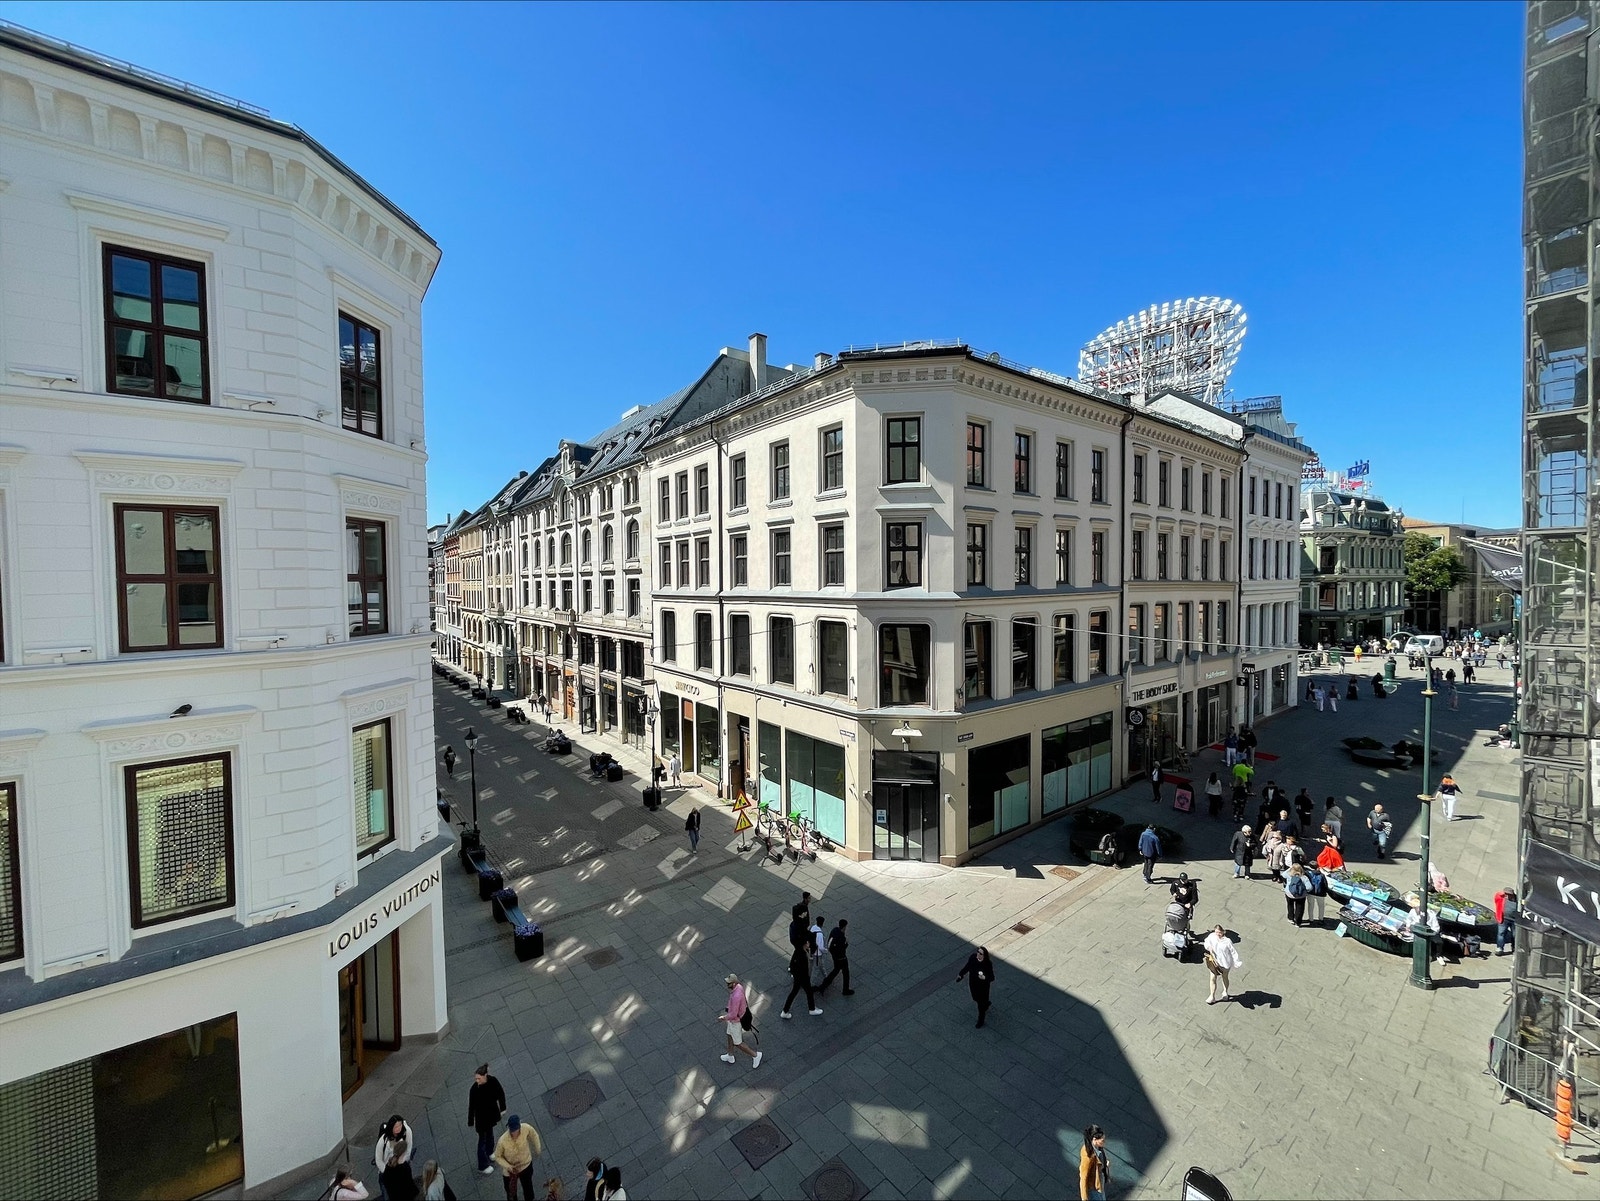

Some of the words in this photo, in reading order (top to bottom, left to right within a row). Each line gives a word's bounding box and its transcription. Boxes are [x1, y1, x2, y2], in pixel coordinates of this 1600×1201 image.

[1132, 690, 1145, 701] THE
[1145, 686, 1162, 698] BODY
[329, 912, 378, 958] LOUIS
[382, 870, 440, 918] VUITTON
[1522, 909, 1557, 928] KIC
